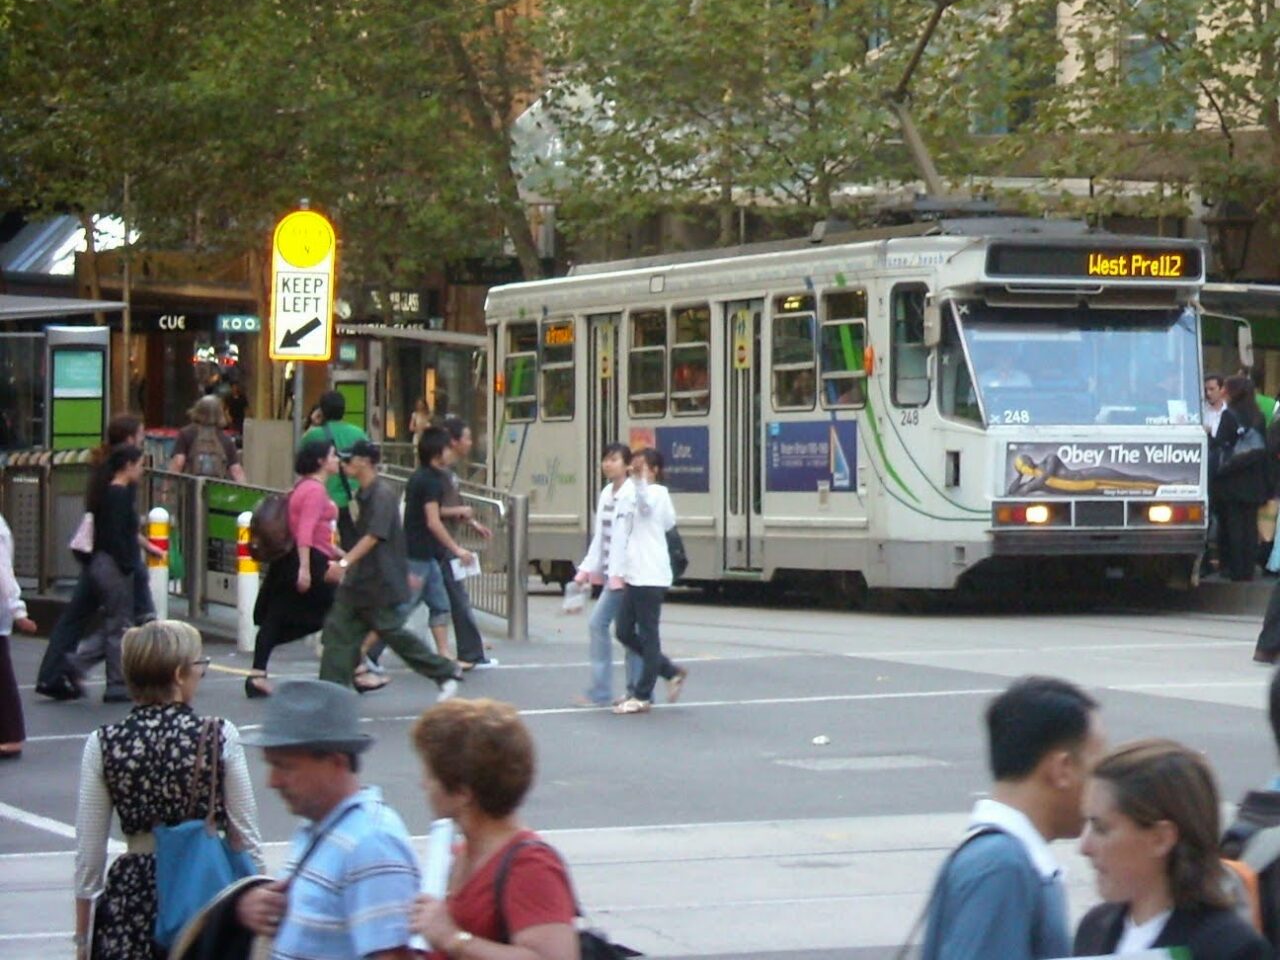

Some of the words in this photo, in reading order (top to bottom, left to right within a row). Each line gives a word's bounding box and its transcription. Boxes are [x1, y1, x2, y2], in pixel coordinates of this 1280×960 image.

[1088, 253, 1127, 276] West
[281, 277, 323, 293] KEEP
[282, 297, 321, 313] LEFT
[158, 314, 186, 330] CUE
[222, 317, 260, 331] KOO
[900, 409, 920, 426] 248
[1003, 410, 1030, 424] 248
[1056, 444, 1104, 467] Obey
[1108, 444, 1140, 464] The
[1144, 444, 1201, 464] Yellow.
